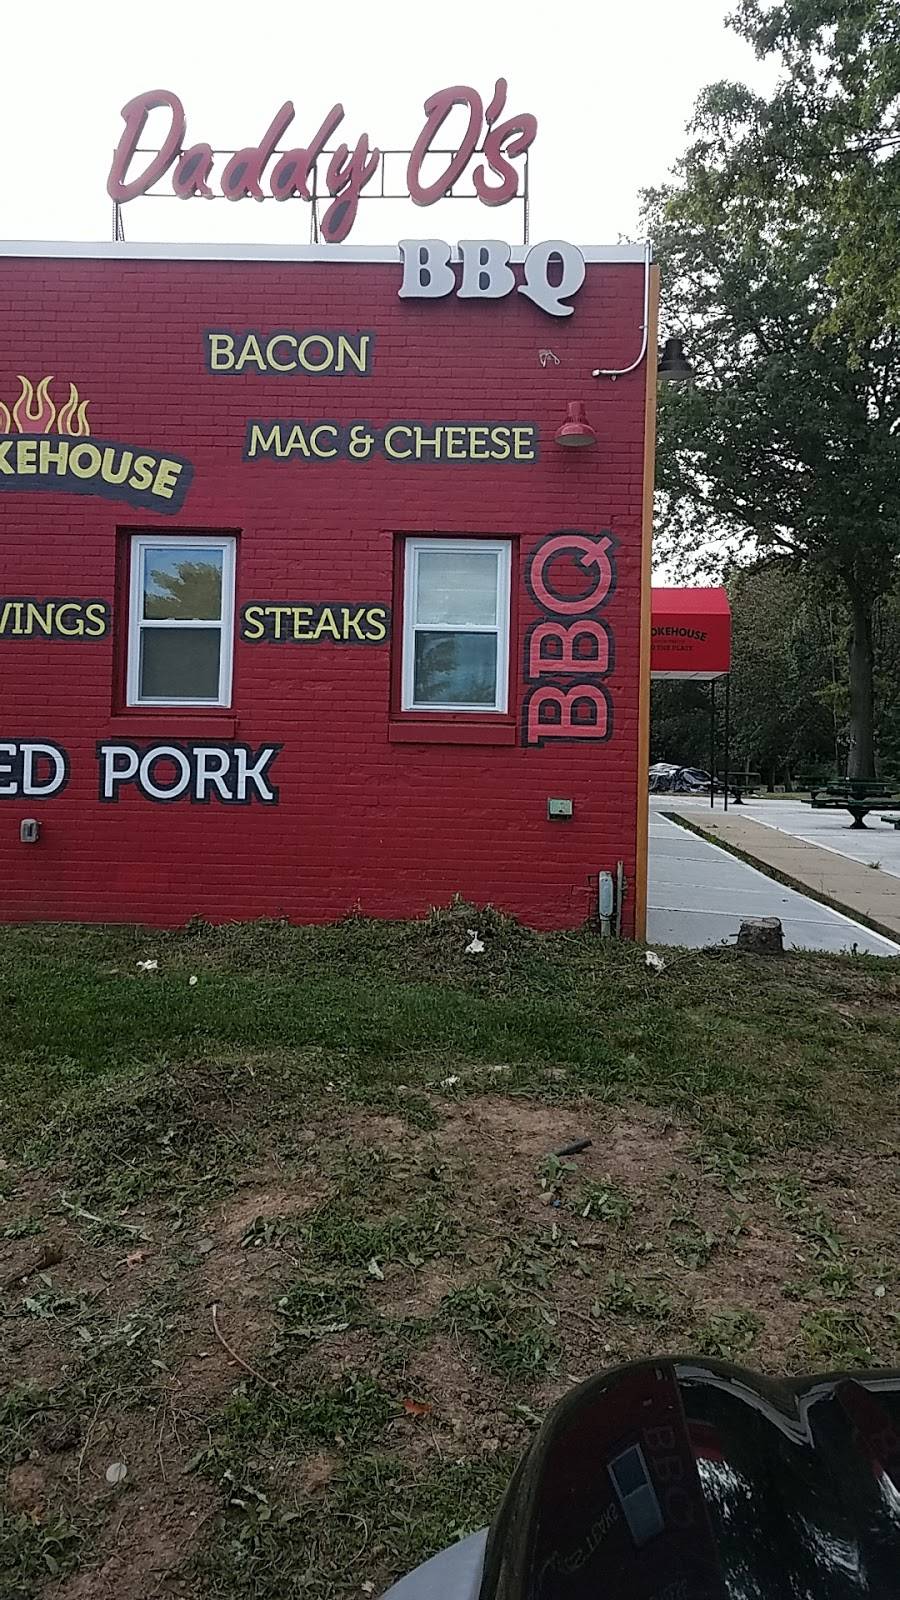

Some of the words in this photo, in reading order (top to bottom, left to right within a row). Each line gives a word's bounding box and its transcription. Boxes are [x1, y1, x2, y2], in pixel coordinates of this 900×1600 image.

[107, 89, 380, 243] Daddy
[407, 78, 537, 207] O's
[398, 239, 586, 317] BBQ
[209, 334, 370, 371] BACON
[248, 425, 337, 458] MAC
[349, 426, 374, 458] &
[384, 426, 534, 460] CHEESE
[244, 606, 387, 640] STEAKS
[528, 535, 613, 739] BBQ
[102, 745, 274, 800] PORK
